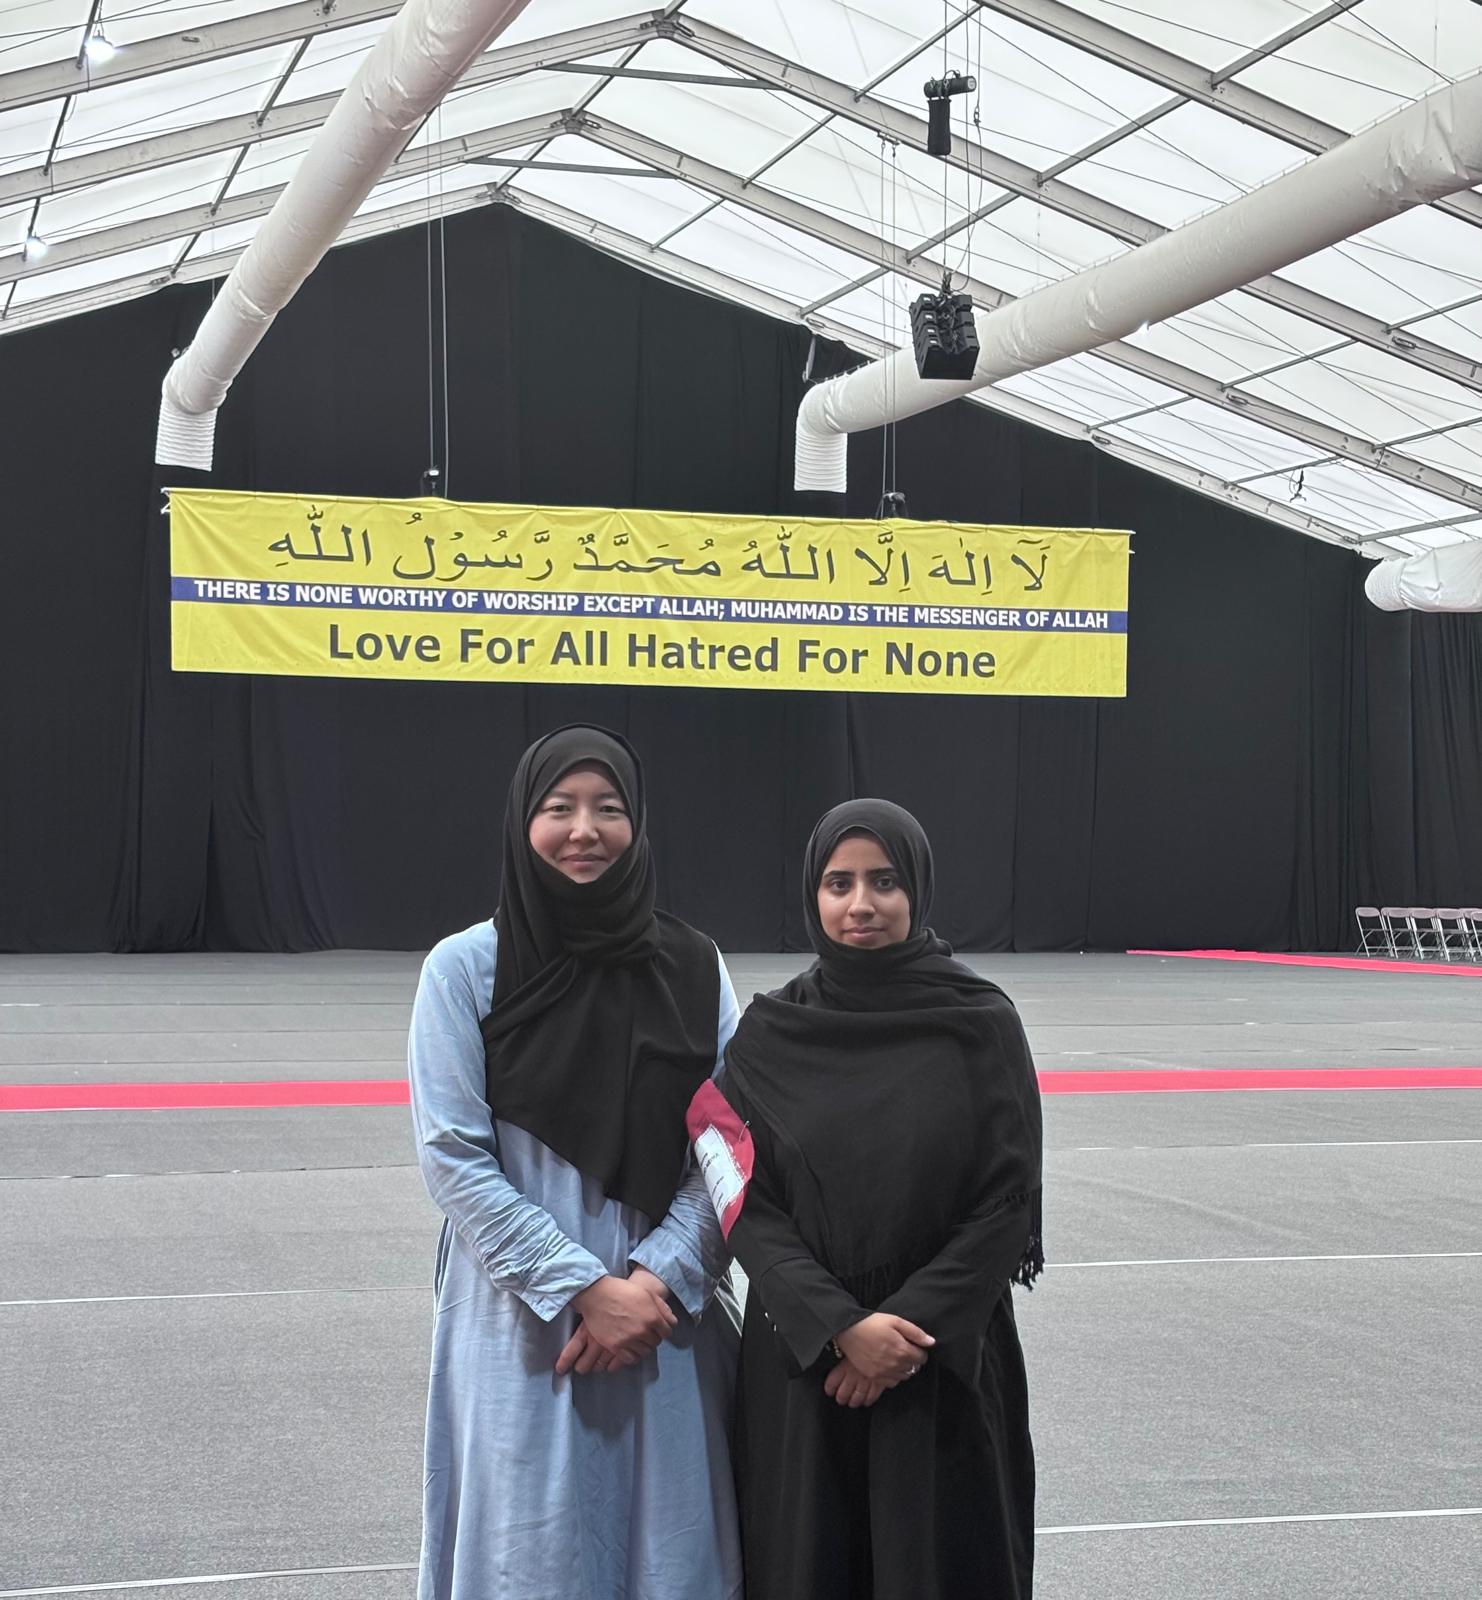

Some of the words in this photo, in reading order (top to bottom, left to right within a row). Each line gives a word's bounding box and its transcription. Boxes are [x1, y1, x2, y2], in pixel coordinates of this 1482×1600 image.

[193, 579, 262, 600] THERE
[266, 583, 290, 602] IS
[295, 584, 353, 604] NONE
[357, 587, 448, 608] WORTHY
[451, 590, 479, 609] OF
[482, 592, 580, 612] WORSHIP
[583, 595, 656, 614] EXCEPT
[658, 598, 725, 619] ALLAH;
[730, 600, 844, 621] MUHAMMAD
[848, 604, 869, 622] IS
[872, 605, 910, 623] THE
[914, 606, 1022, 627] MESSENGER
[1025, 610, 1050, 627] OF
[1052, 611, 1109, 629] ALLAH
[330, 623, 440, 663] Love
[460, 628, 535, 665] For
[550, 630, 608, 666] All
[628, 633, 779, 673] Hatred
[798, 639, 869, 674] For
[885, 642, 996, 678] None
